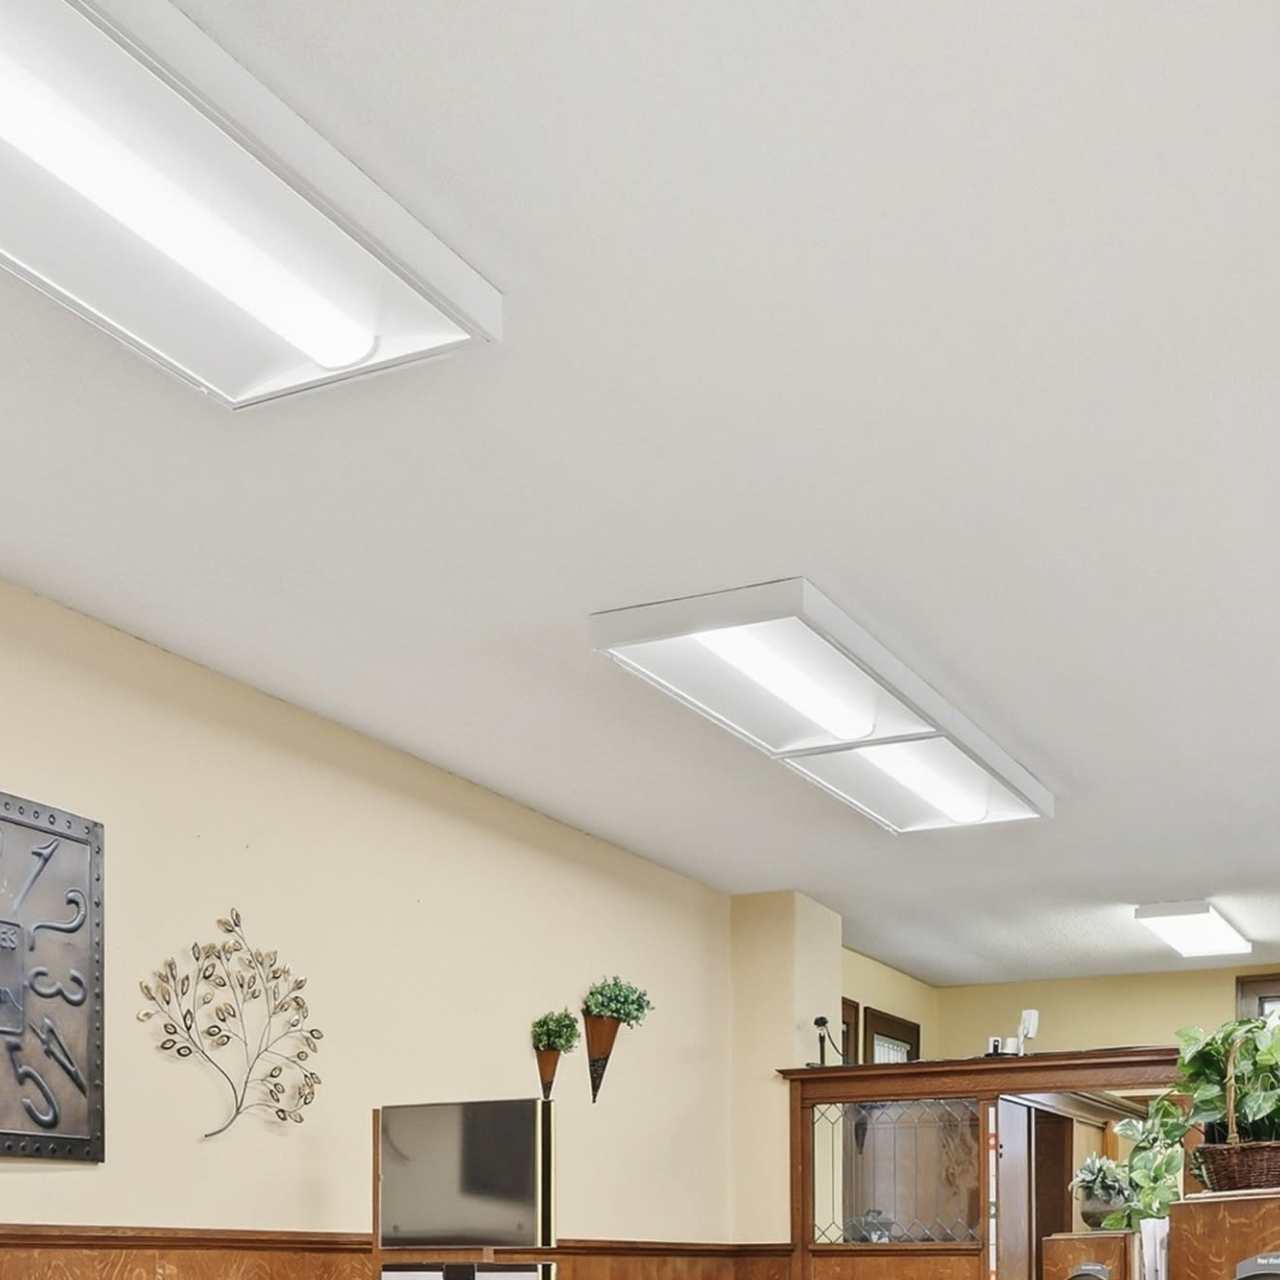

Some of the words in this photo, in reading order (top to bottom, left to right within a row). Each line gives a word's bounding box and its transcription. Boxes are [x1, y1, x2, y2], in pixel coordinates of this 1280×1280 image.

[13, 838, 60, 911] 1
[29, 889, 88, 951] 2
[28, 966, 88, 1006] 3
[5, 1038, 61, 1129] 5
[30, 1016, 88, 1097] 4
